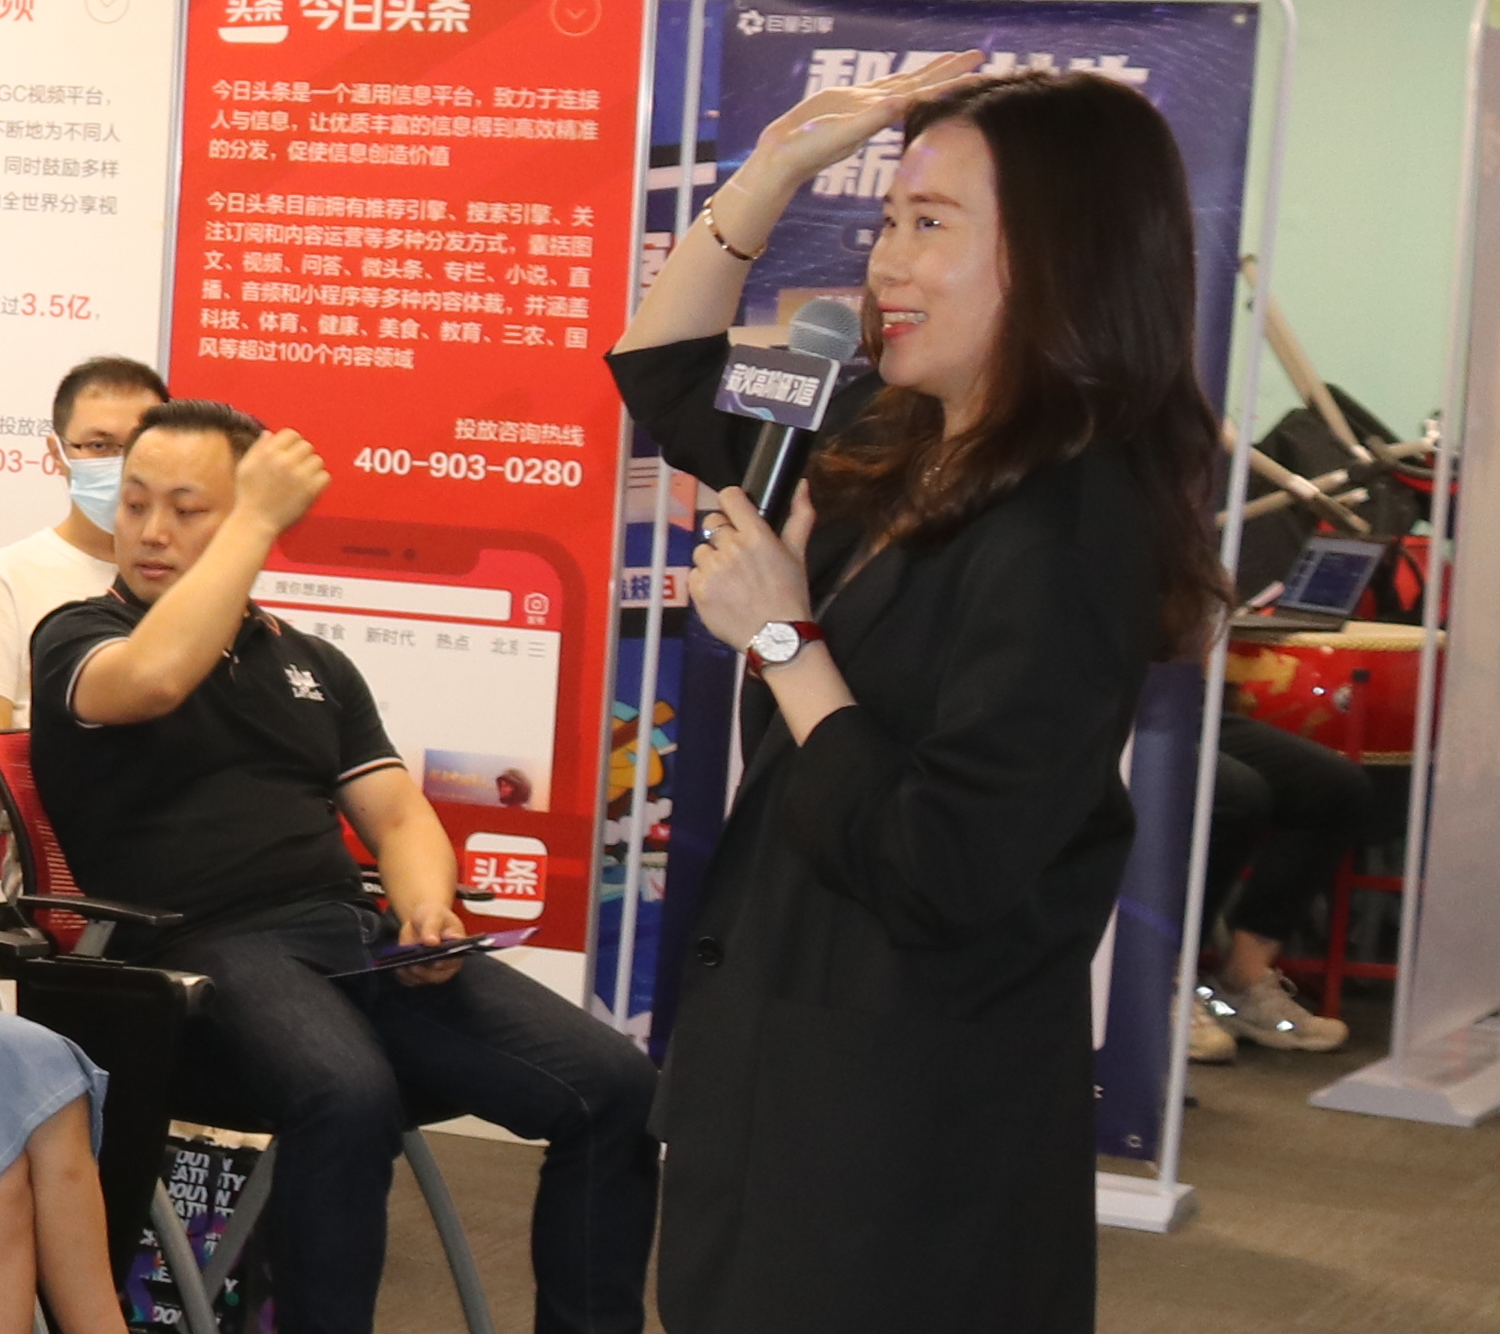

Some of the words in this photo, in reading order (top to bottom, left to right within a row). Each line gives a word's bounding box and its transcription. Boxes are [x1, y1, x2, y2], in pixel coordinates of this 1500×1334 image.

[211, 78, 601, 111] 今日头条是一个通用信息平台，致力于连接
[209, 109, 600, 142] 人与信息，让优质丰富的信息得到高效精准
[208, 138, 451, 167] 的分发，促使信息创造价值
[198, 336, 416, 370] 风等超过100个内容领域
[454, 417, 586, 448] 投放咨询热线
[353, 446, 584, 488] 400-903-0280
[471, 856, 538, 896] 头条
